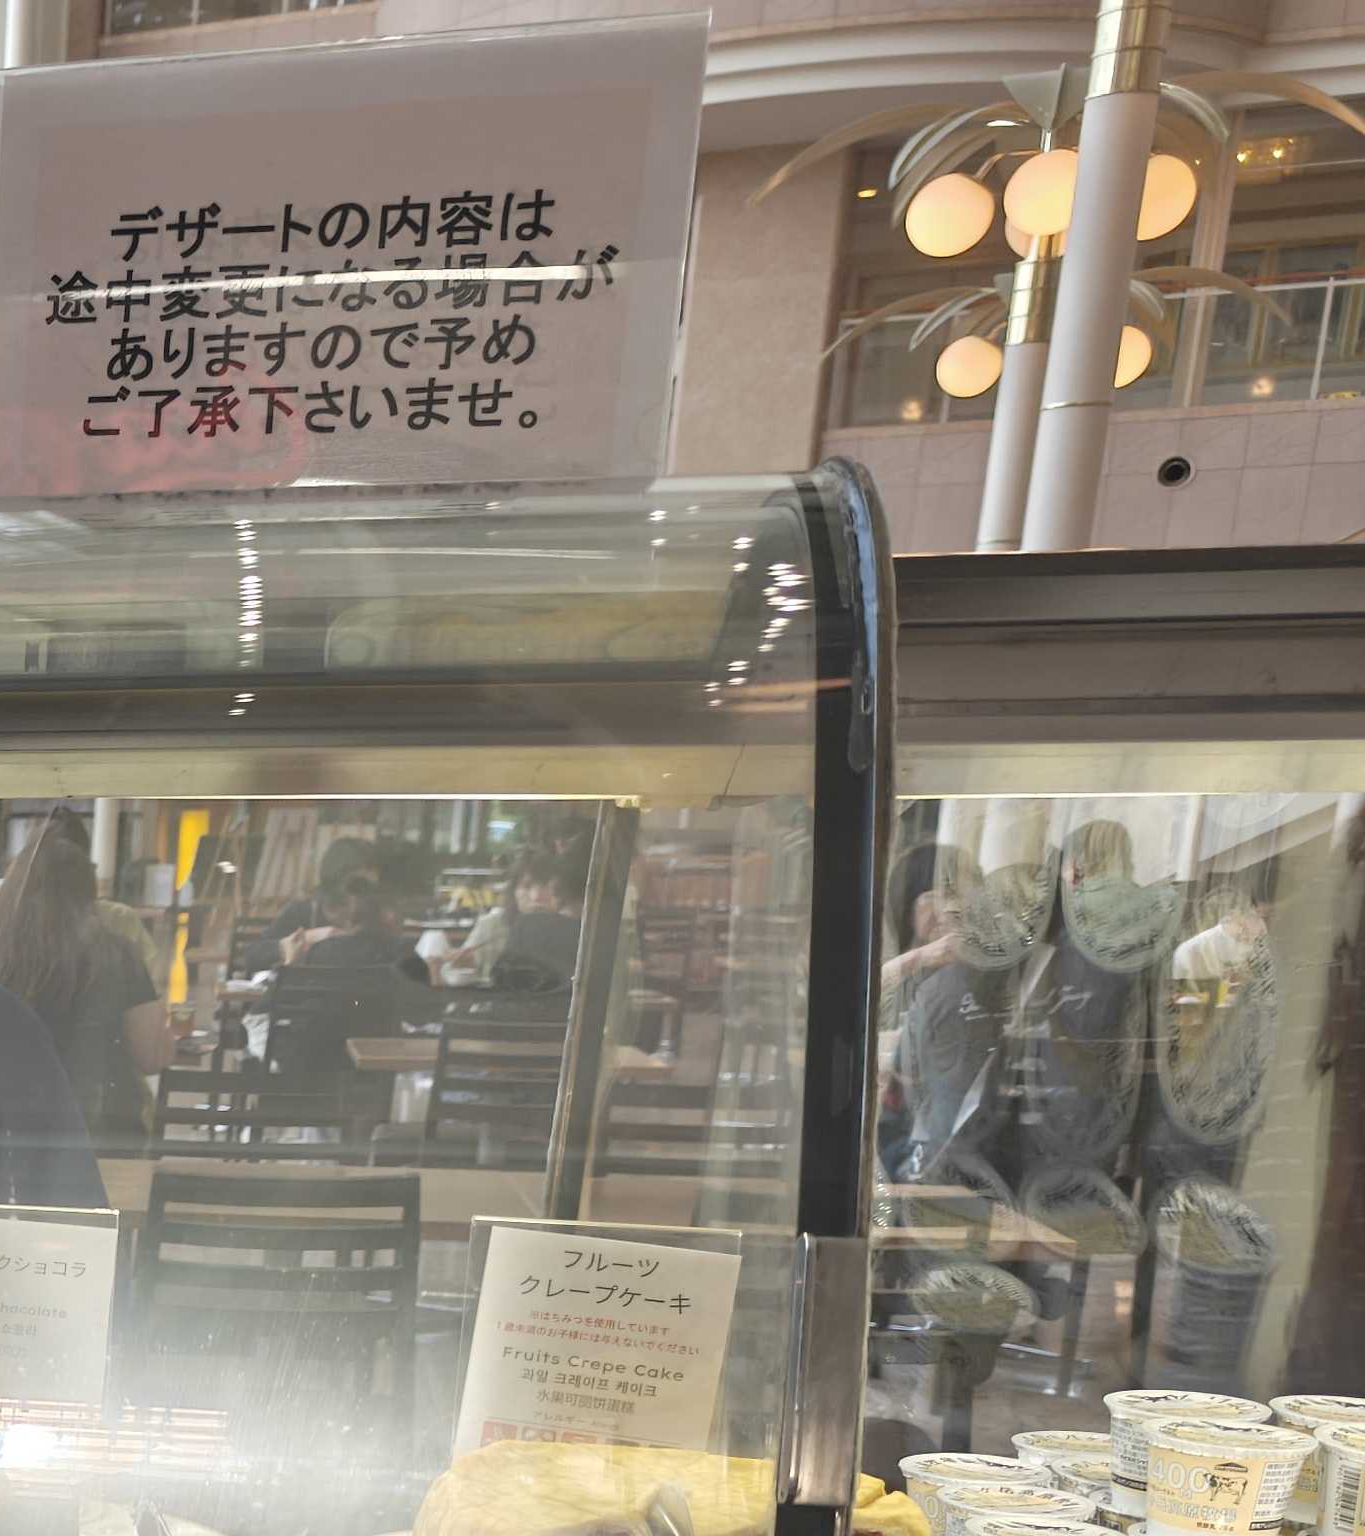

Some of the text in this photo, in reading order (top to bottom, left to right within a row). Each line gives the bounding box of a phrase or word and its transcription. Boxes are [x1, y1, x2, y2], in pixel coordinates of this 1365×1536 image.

[110, 188, 556, 262] デザートの内容は
[45, 243, 621, 328] 途中変更になる場合が
[106, 313, 538, 381] ありますので予め
[82, 377, 540, 438] ご了承下さいませ。
[564, 1249, 660, 1278] フルーツ
[519, 1275, 692, 1315] クレープケーキ
[501, 1346, 685, 1382] Fruits Crepe Cake
